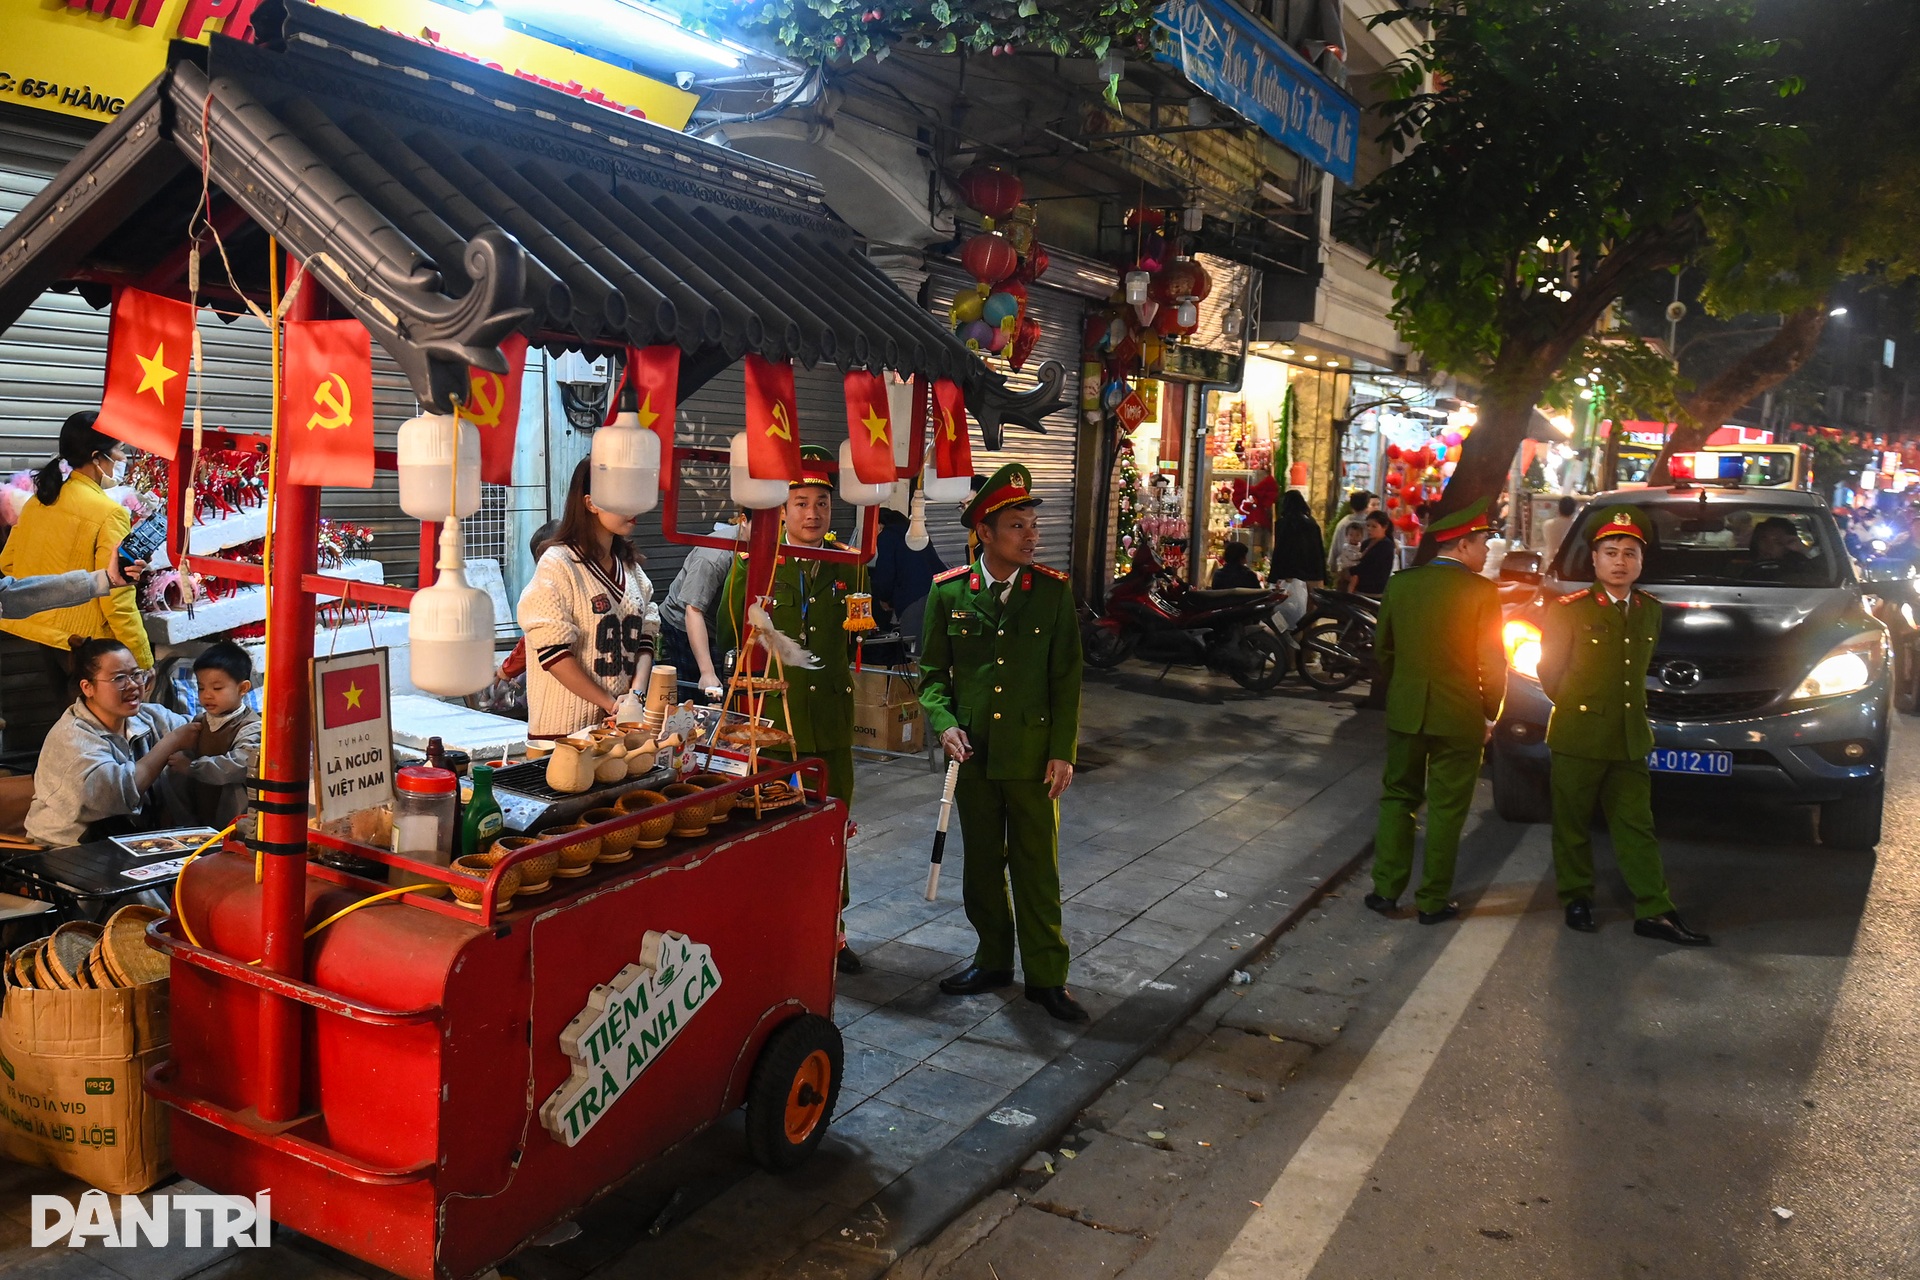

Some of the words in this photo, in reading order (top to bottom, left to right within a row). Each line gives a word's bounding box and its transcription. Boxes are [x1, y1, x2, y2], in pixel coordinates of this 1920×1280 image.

[61, 85, 125, 115] HÀNG
[345, 747, 383, 770] NGƯỜI
[1645, 750, 1729, 773] A-012.10
[328, 778, 355, 798] VIỆT
[358, 771, 385, 790] NAM
[584, 982, 650, 1067] TIỆM
[563, 1063, 620, 1140] TRÀ
[626, 999, 678, 1081] ANH
[683, 953, 717, 1011] CẢ
[43, 1096, 57, 1111] VỊ
[60, 1102, 86, 1115] GIA
[80, 1124, 117, 1149] BỘT
